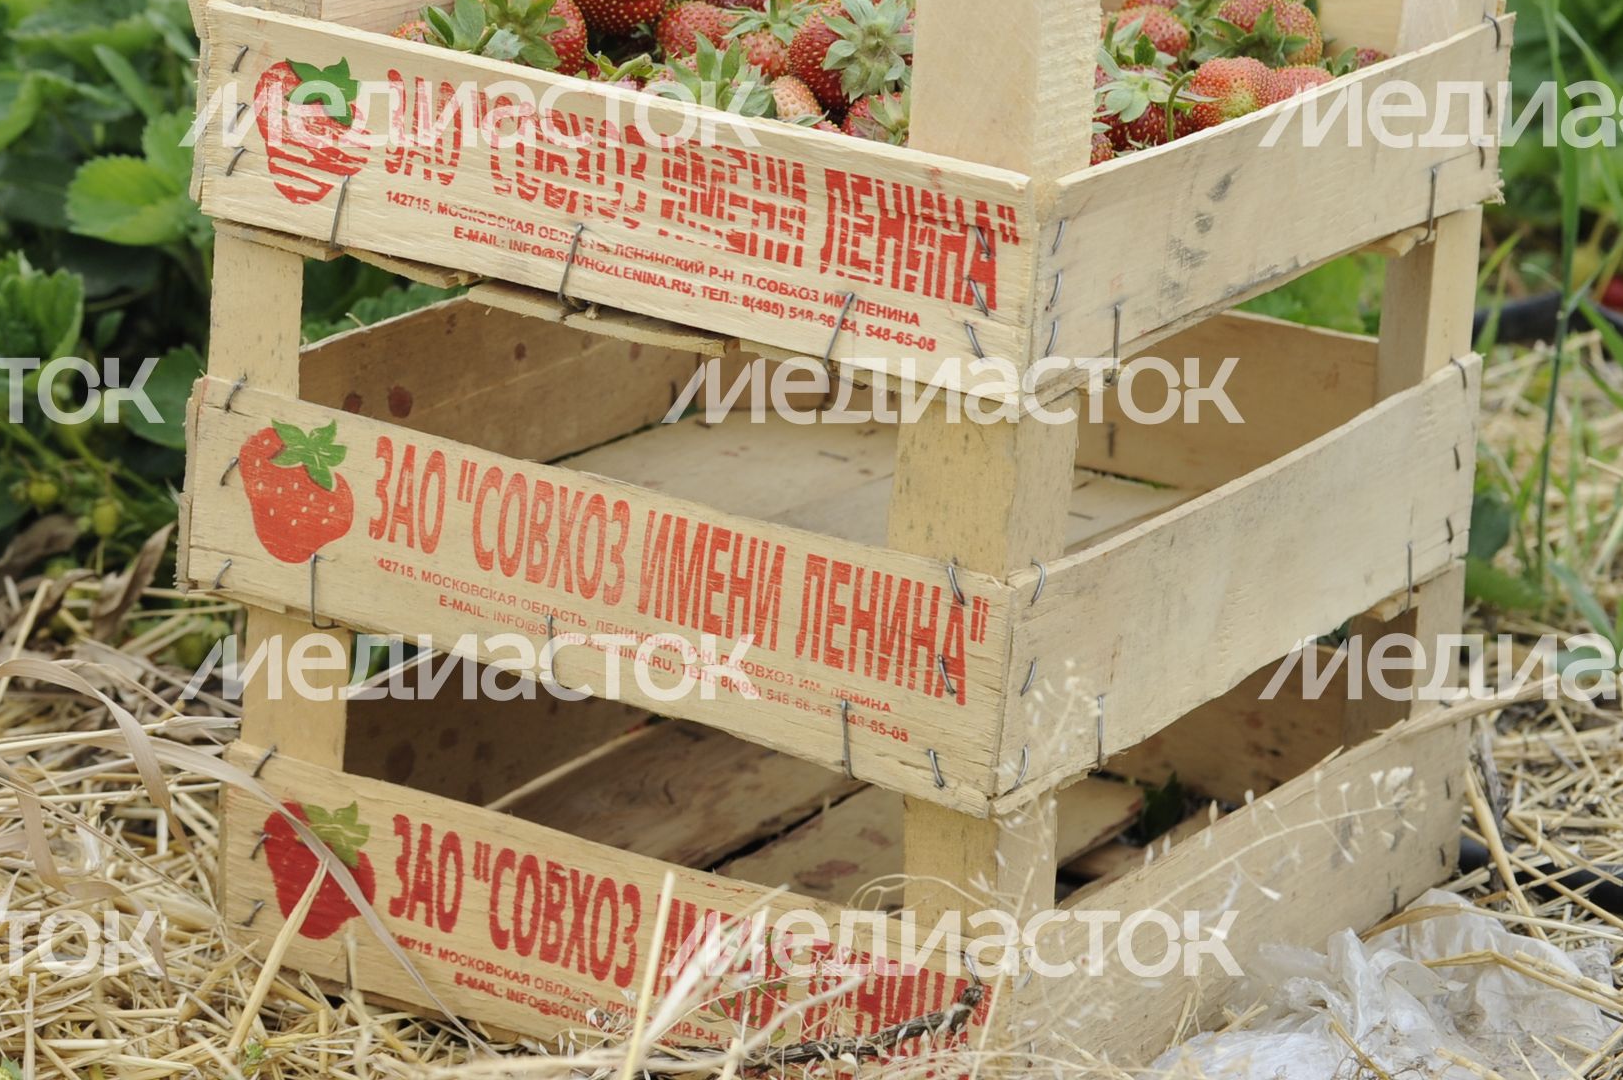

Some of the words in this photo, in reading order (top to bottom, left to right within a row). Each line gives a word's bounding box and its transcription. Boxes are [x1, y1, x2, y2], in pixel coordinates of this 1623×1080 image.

[384, 68, 462, 186] ЗАО
[386, 190, 433, 215] 142715,
[614, 242, 705, 274] ЛЕНИНСКИЙ
[854, 299, 922, 327] ЛЕНИНА
[368, 435, 447, 555] ЗАО
[457, 459, 631, 606] "СОВХОЗ
[637, 509, 787, 652] ИМЕНИ
[795, 553, 990, 706] ЛЕНИНА"
[374, 556, 418, 581] 42715,
[421, 570, 517, 608] МОСКОВСКАЯ
[595, 620, 684, 653] ЛЕНИНСКИЙ
[831, 687, 892, 713] ЛЕНИНА
[843, 711, 909, 742] 48-65-05
[388, 813, 464, 934] ЗАО
[473, 840, 642, 989] "СОВХОЗ
[438, 946, 531, 988] МОСКОВСКАЯ
